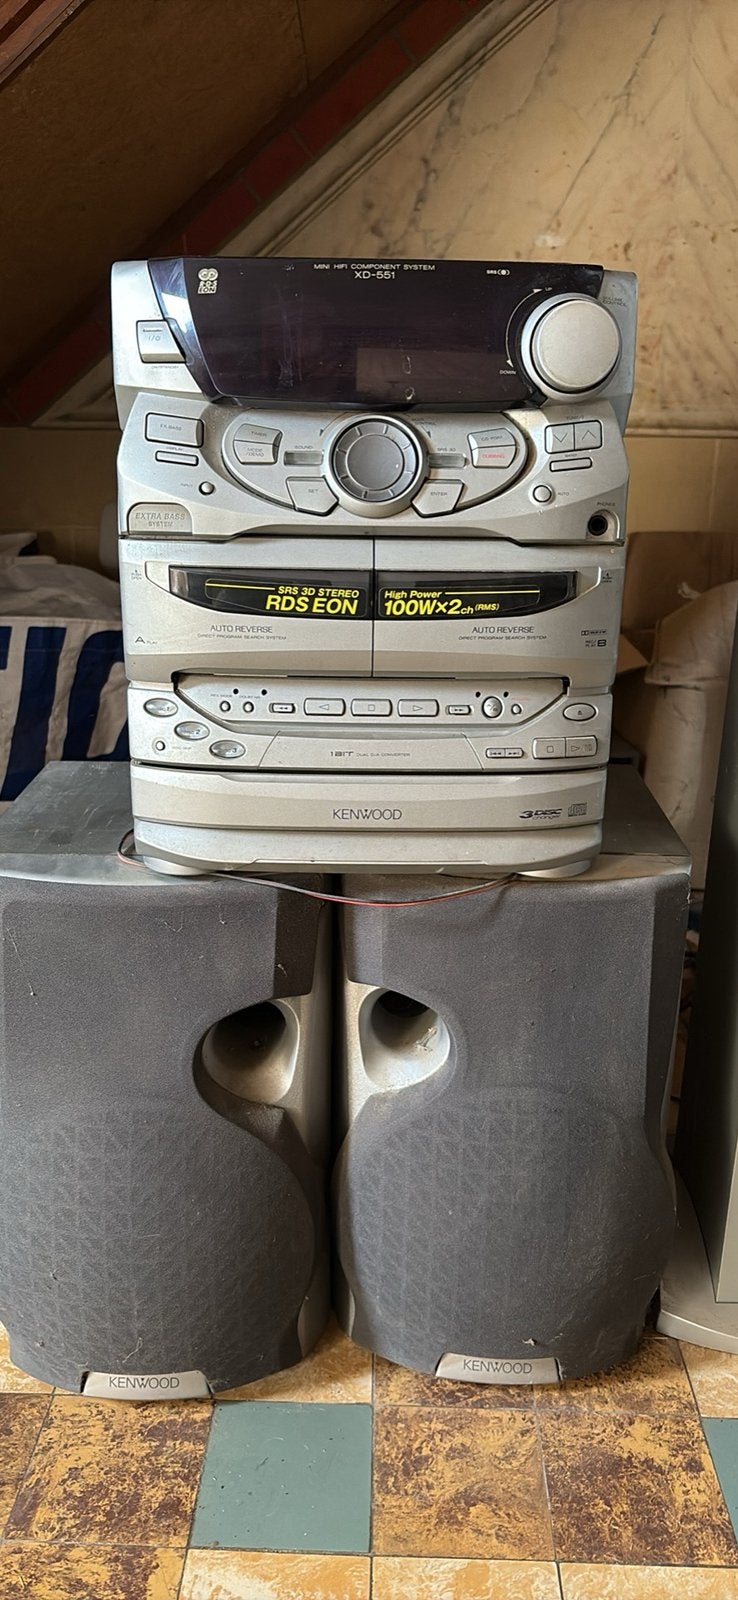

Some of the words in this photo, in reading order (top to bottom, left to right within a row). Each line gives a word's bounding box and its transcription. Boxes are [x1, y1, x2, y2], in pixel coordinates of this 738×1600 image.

[354, 270, 396, 280] XD-551
[135, 512, 162, 520] EXTRA
[164, 512, 186, 520] BASS
[277, 586, 298, 595] SRS
[301, 587, 316, 596] 3D
[318, 588, 360, 598] STEREO
[384, 590, 408, 601] High
[410, 590, 443, 599] Power
[265, 594, 309, 613] RDS
[312, 597, 358, 615] EON
[475, 603, 500, 612] (RMS)
[210, 625, 233, 633] AUTO
[235, 625, 273, 633] REVERSE
[472, 626, 495, 634] AUTO
[497, 626, 535, 634] REVERSE
[135, 636, 145, 644] A
[332, 808, 403, 821] KENWOOD
[463, 1359, 532, 1374] KENWOOD
[109, 1376, 179, 1389] KENWOOD
